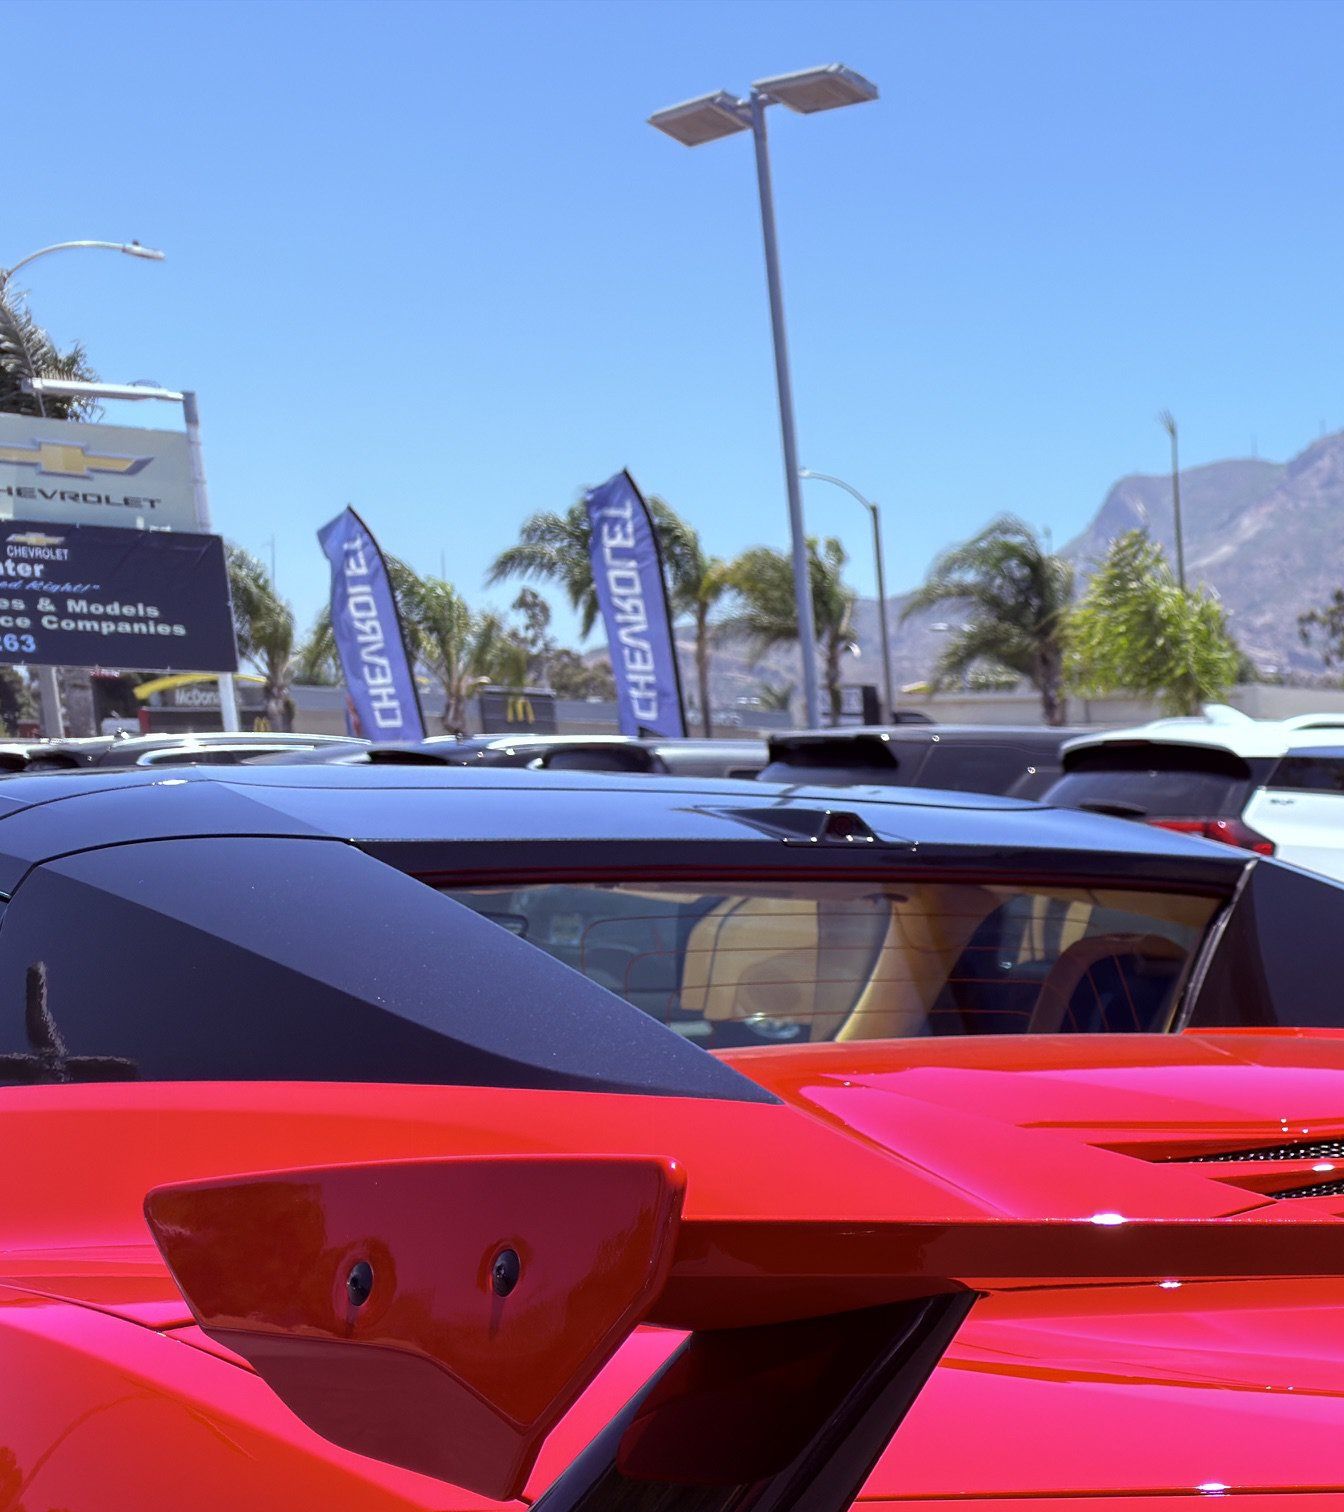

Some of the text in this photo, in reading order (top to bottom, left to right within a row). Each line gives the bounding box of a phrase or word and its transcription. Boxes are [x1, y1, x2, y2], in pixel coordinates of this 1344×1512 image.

[0, 486, 161, 509] HEVROLET
[6, 545, 69, 560] CHEVROLET
[0, 559, 44, 577] ter
[0, 597, 160, 618] es & Models
[0, 614, 187, 636] ce Companies
[0, 632, 37, 653] 63
